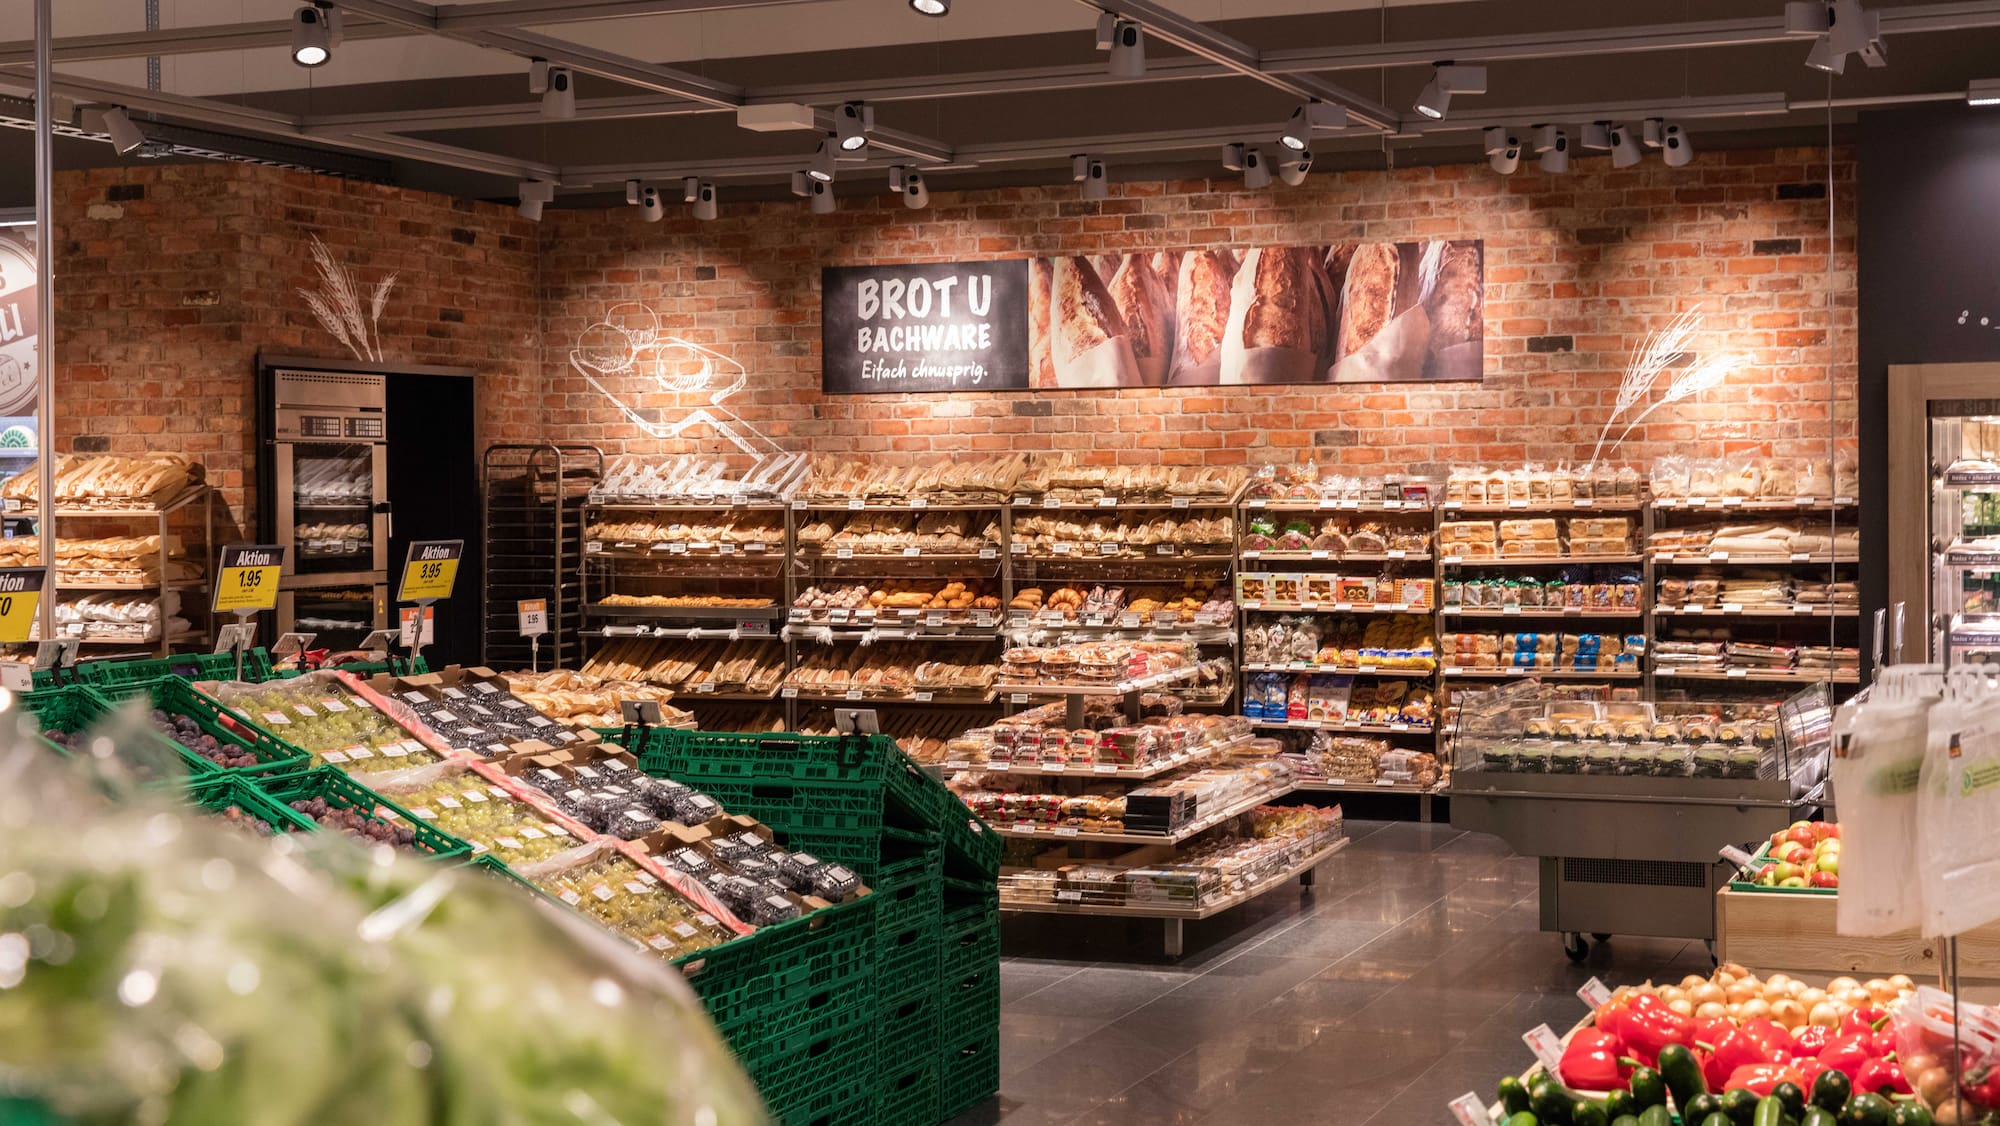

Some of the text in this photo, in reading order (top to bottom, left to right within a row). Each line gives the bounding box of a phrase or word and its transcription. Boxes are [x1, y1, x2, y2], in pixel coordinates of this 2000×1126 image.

[857, 274, 992, 321] BROT U
[857, 322, 992, 353] BACHWARE
[861, 358, 988, 385] Eifach chnusprig.
[235, 550, 270, 566] Aktion
[420, 545, 450, 560] Aktion
[239, 569, 262, 587] 1.95
[420, 562, 442, 578] 3.95
